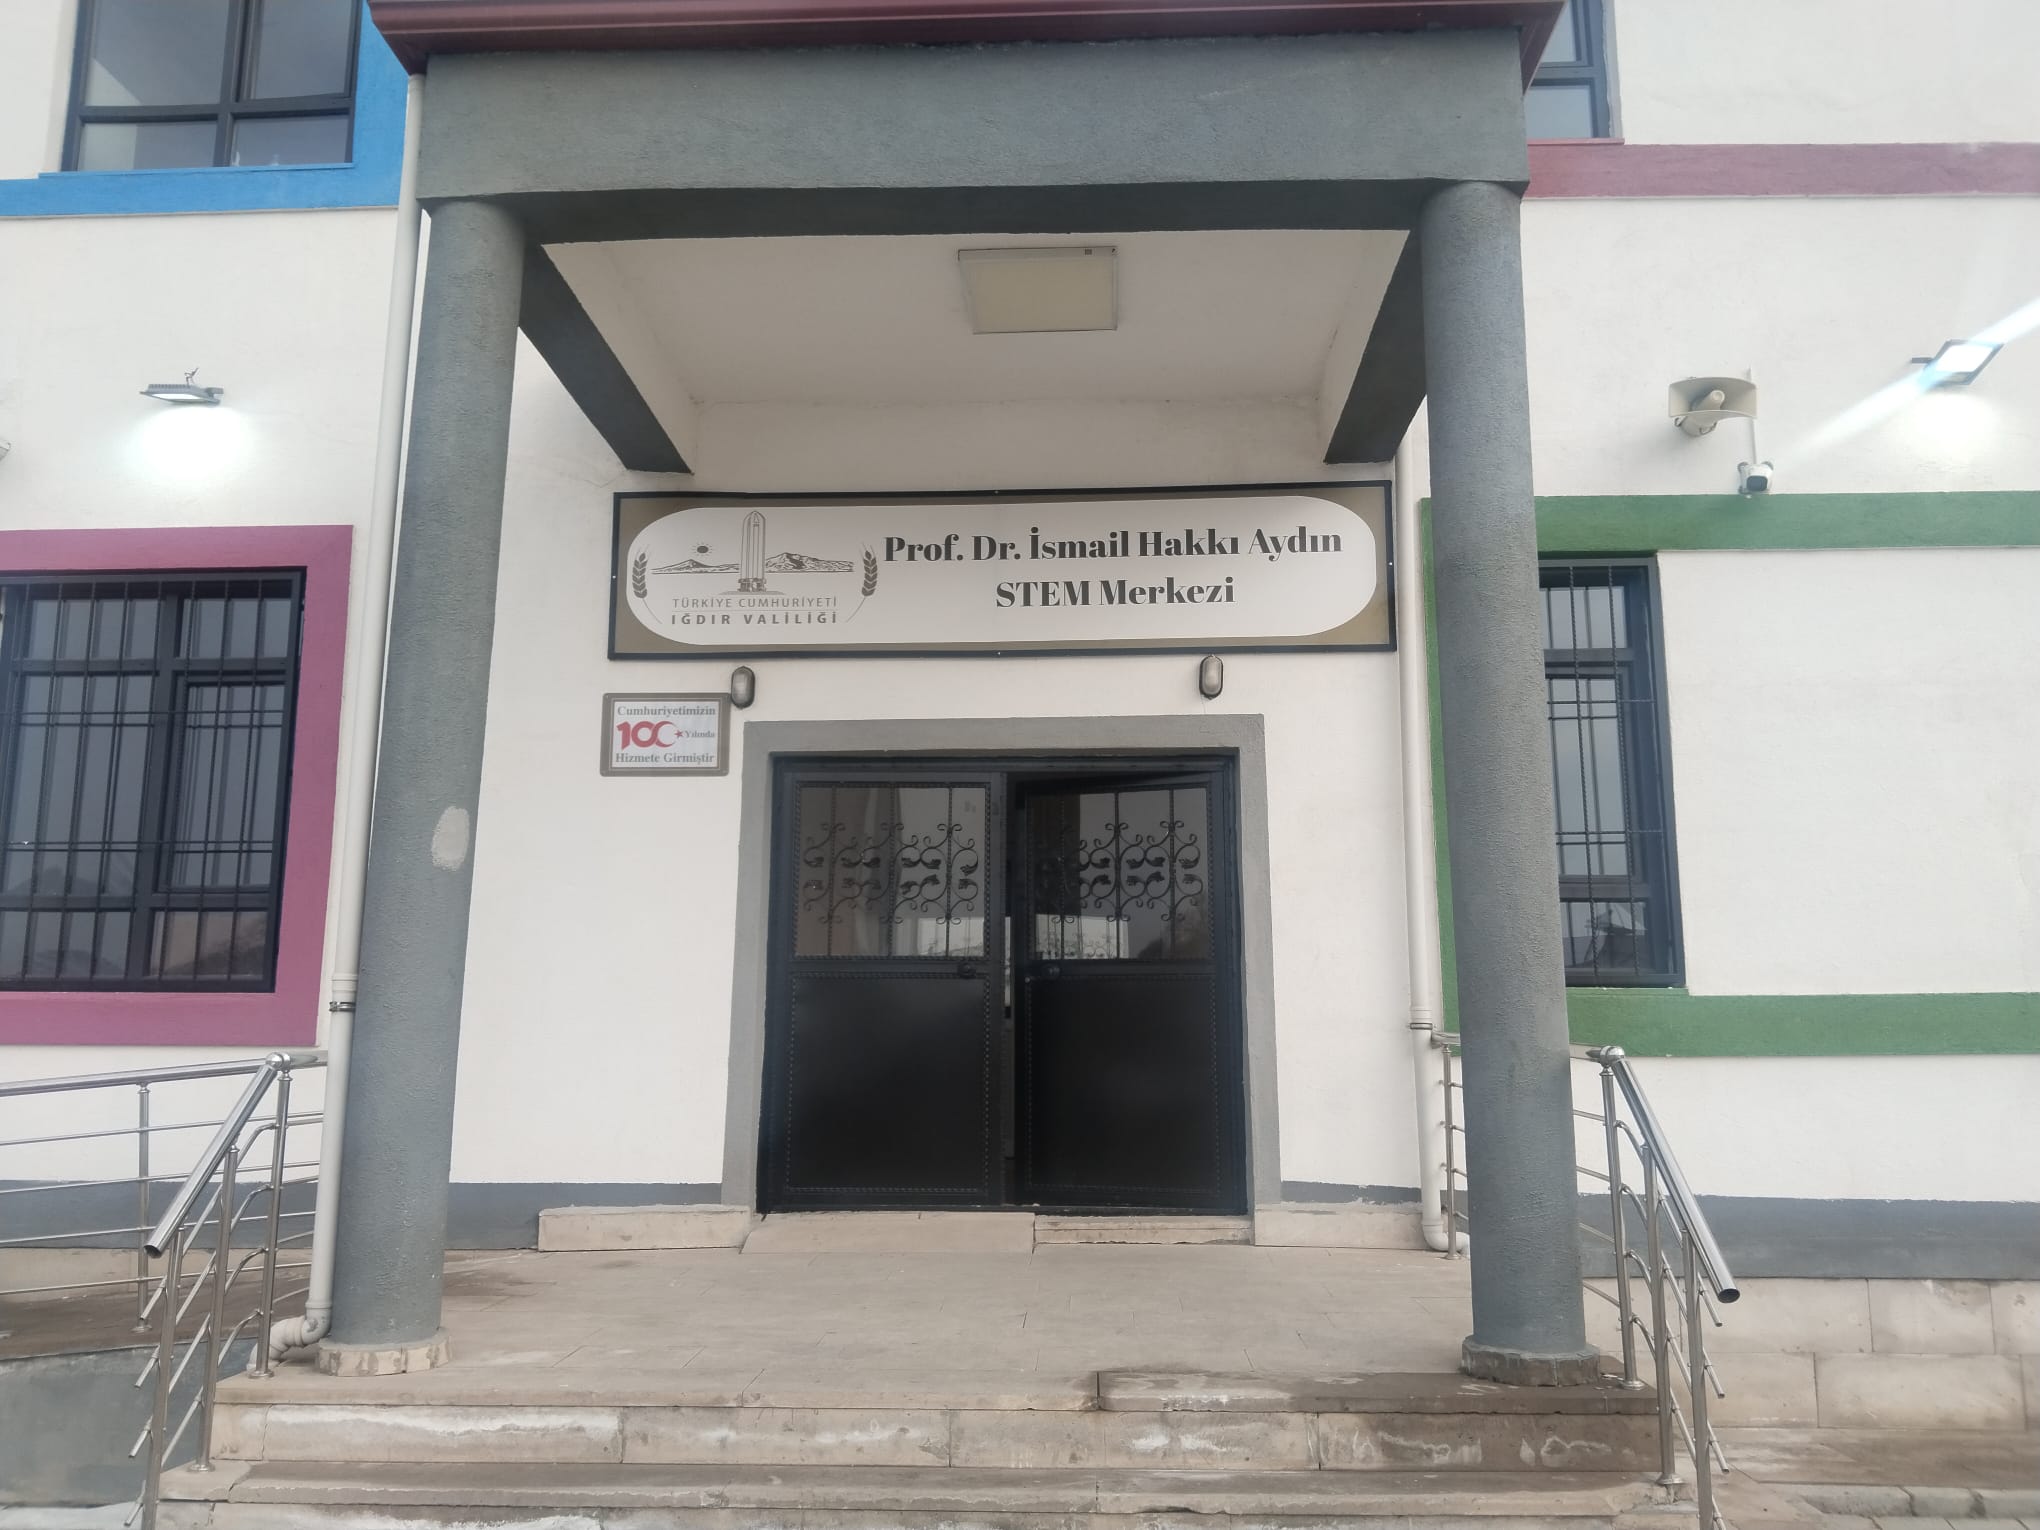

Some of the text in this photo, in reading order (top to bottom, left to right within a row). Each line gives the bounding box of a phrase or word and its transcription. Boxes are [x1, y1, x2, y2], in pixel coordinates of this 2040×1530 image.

[884, 526, 1344, 562] Prof. Dr. İsmail Hakkı Aydın
[996, 576, 1236, 608] STEM Merkezi
[672, 596, 837, 609] TÜRKİYE CUMHURİYETİ
[671, 612, 837, 625] IĞDIR VALİLİĞİ
[617, 705, 716, 718] Cumhuriyetimizin
[615, 752, 715, 765] Hizmete Girmiştir
